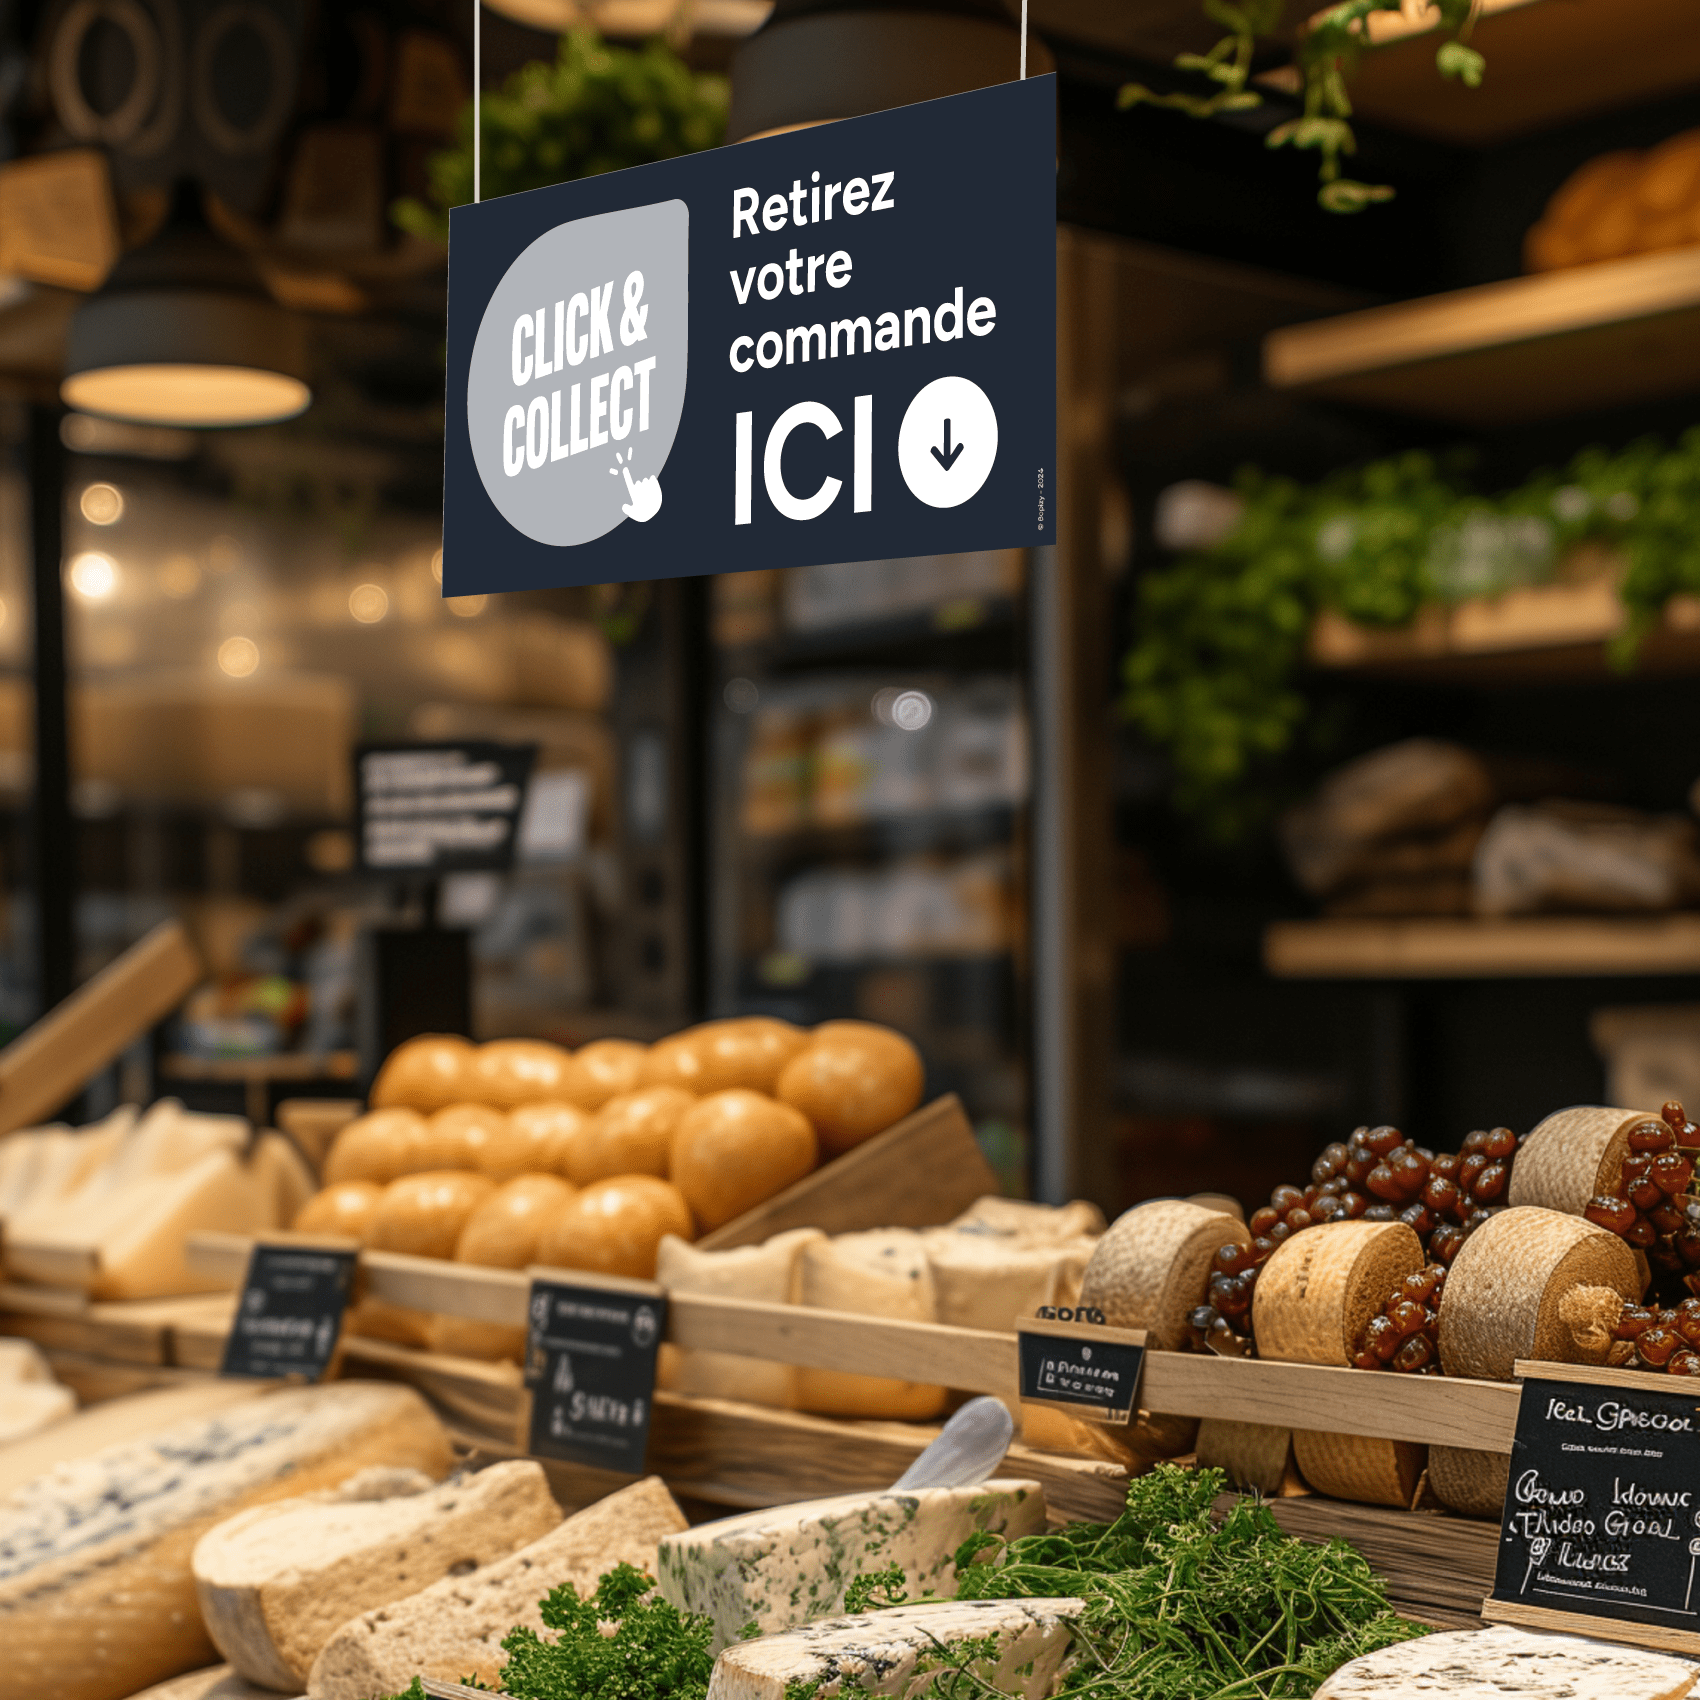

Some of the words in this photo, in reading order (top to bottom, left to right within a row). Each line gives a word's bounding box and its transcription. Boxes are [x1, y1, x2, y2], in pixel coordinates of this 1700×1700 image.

[732, 171, 895, 239] Retirez
[729, 249, 853, 305] votre
[511, 292, 615, 387] CLICK
[620, 270, 649, 347] &
[728, 287, 997, 373] commande
[502, 356, 657, 478] COLLECT
[734, 394, 873, 526] ICI
